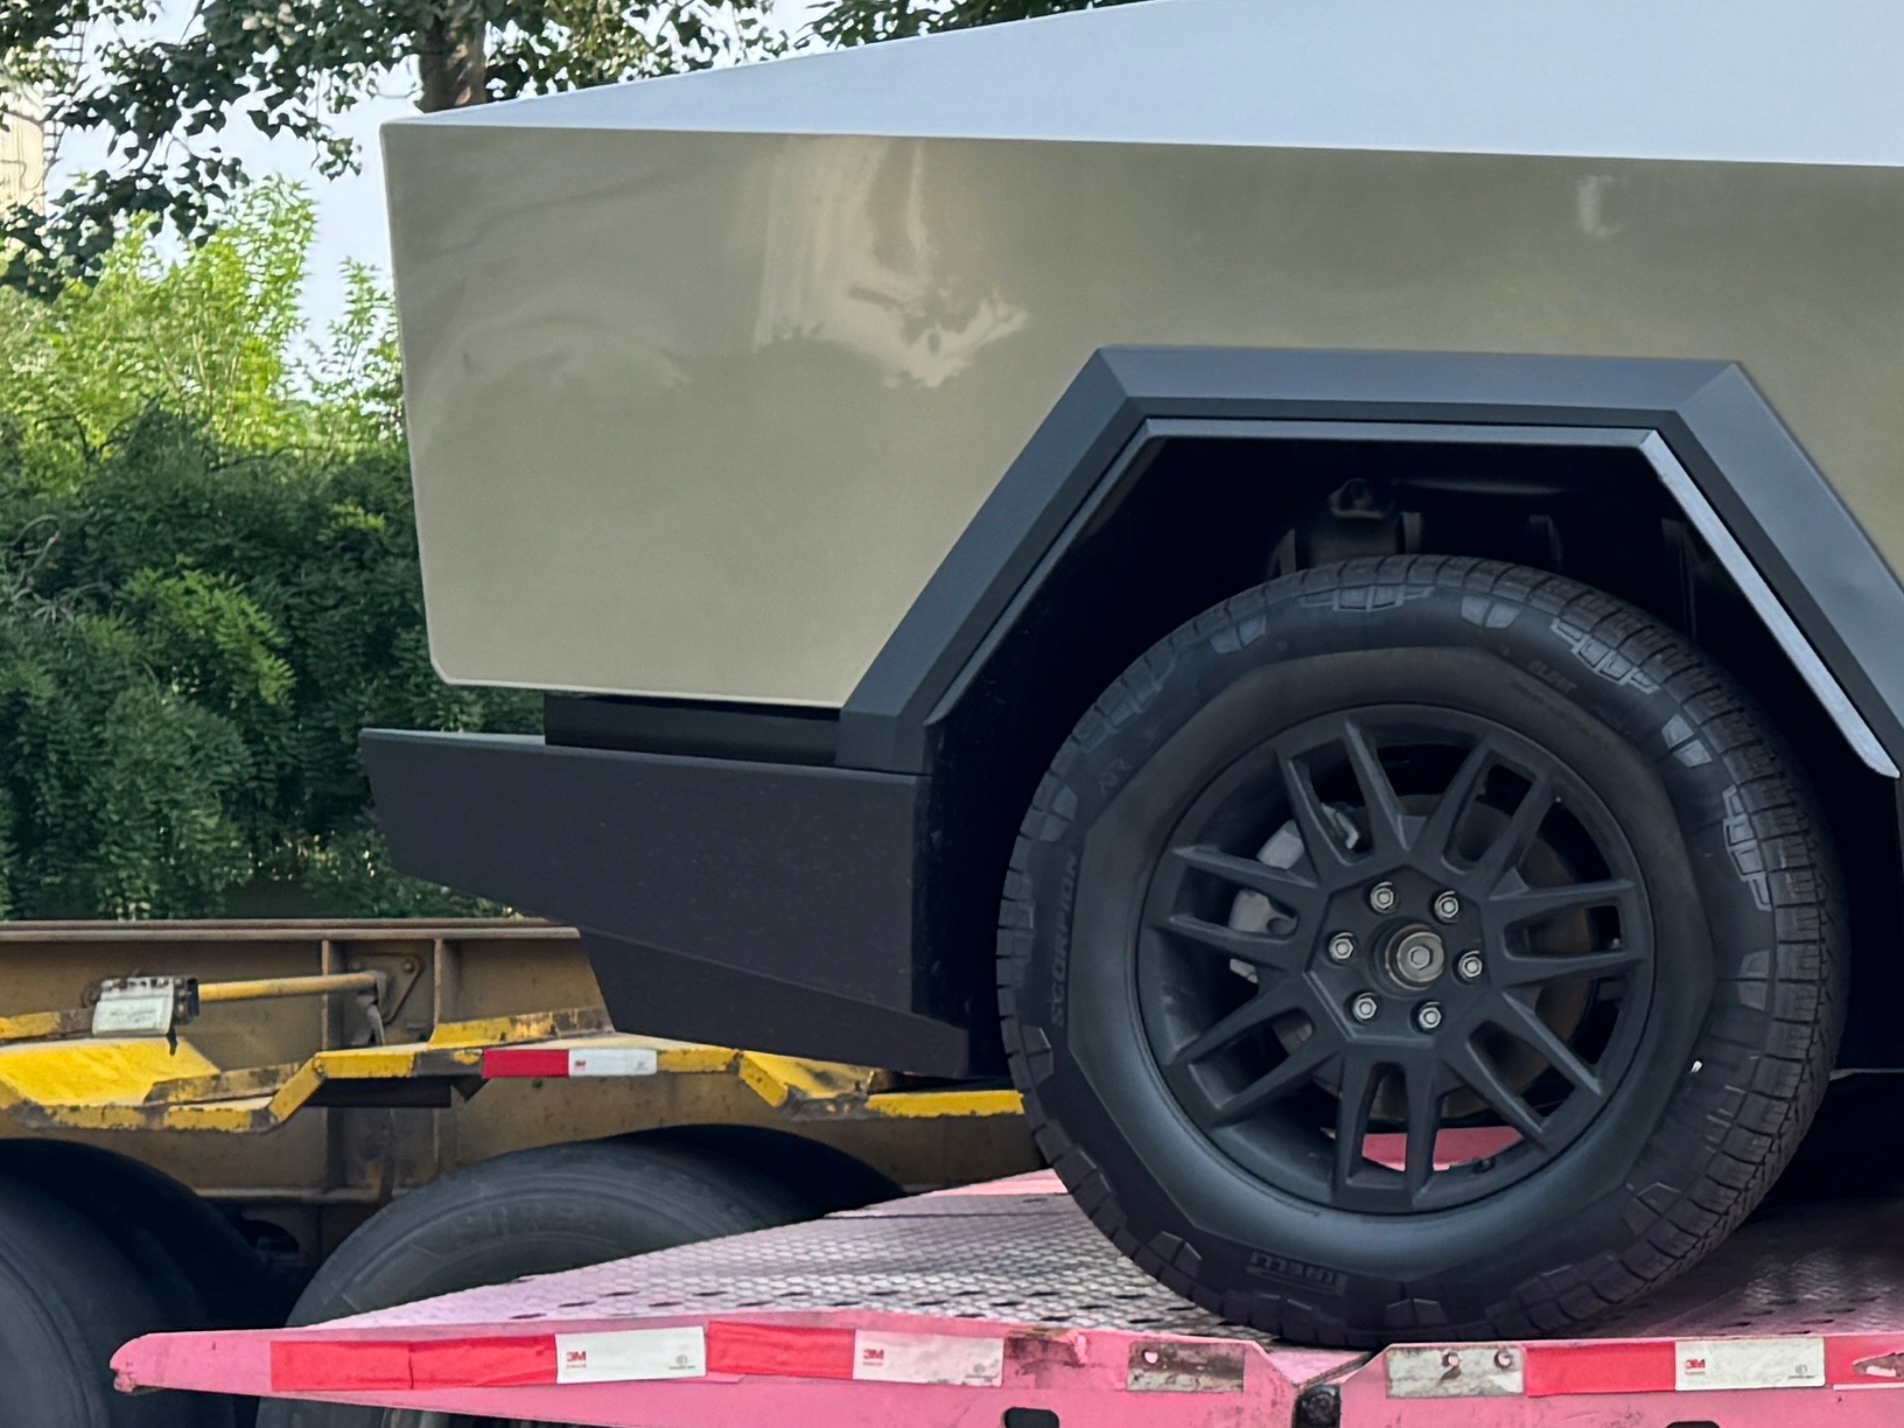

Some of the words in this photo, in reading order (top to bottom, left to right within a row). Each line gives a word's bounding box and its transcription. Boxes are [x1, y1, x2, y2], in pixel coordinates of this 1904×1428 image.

[1050, 850, 1080, 1029] SCORPION
[566, 1351, 587, 1362] 3M
[863, 1349, 884, 1360] 3M
[1685, 1359, 1705, 1370] 3M
